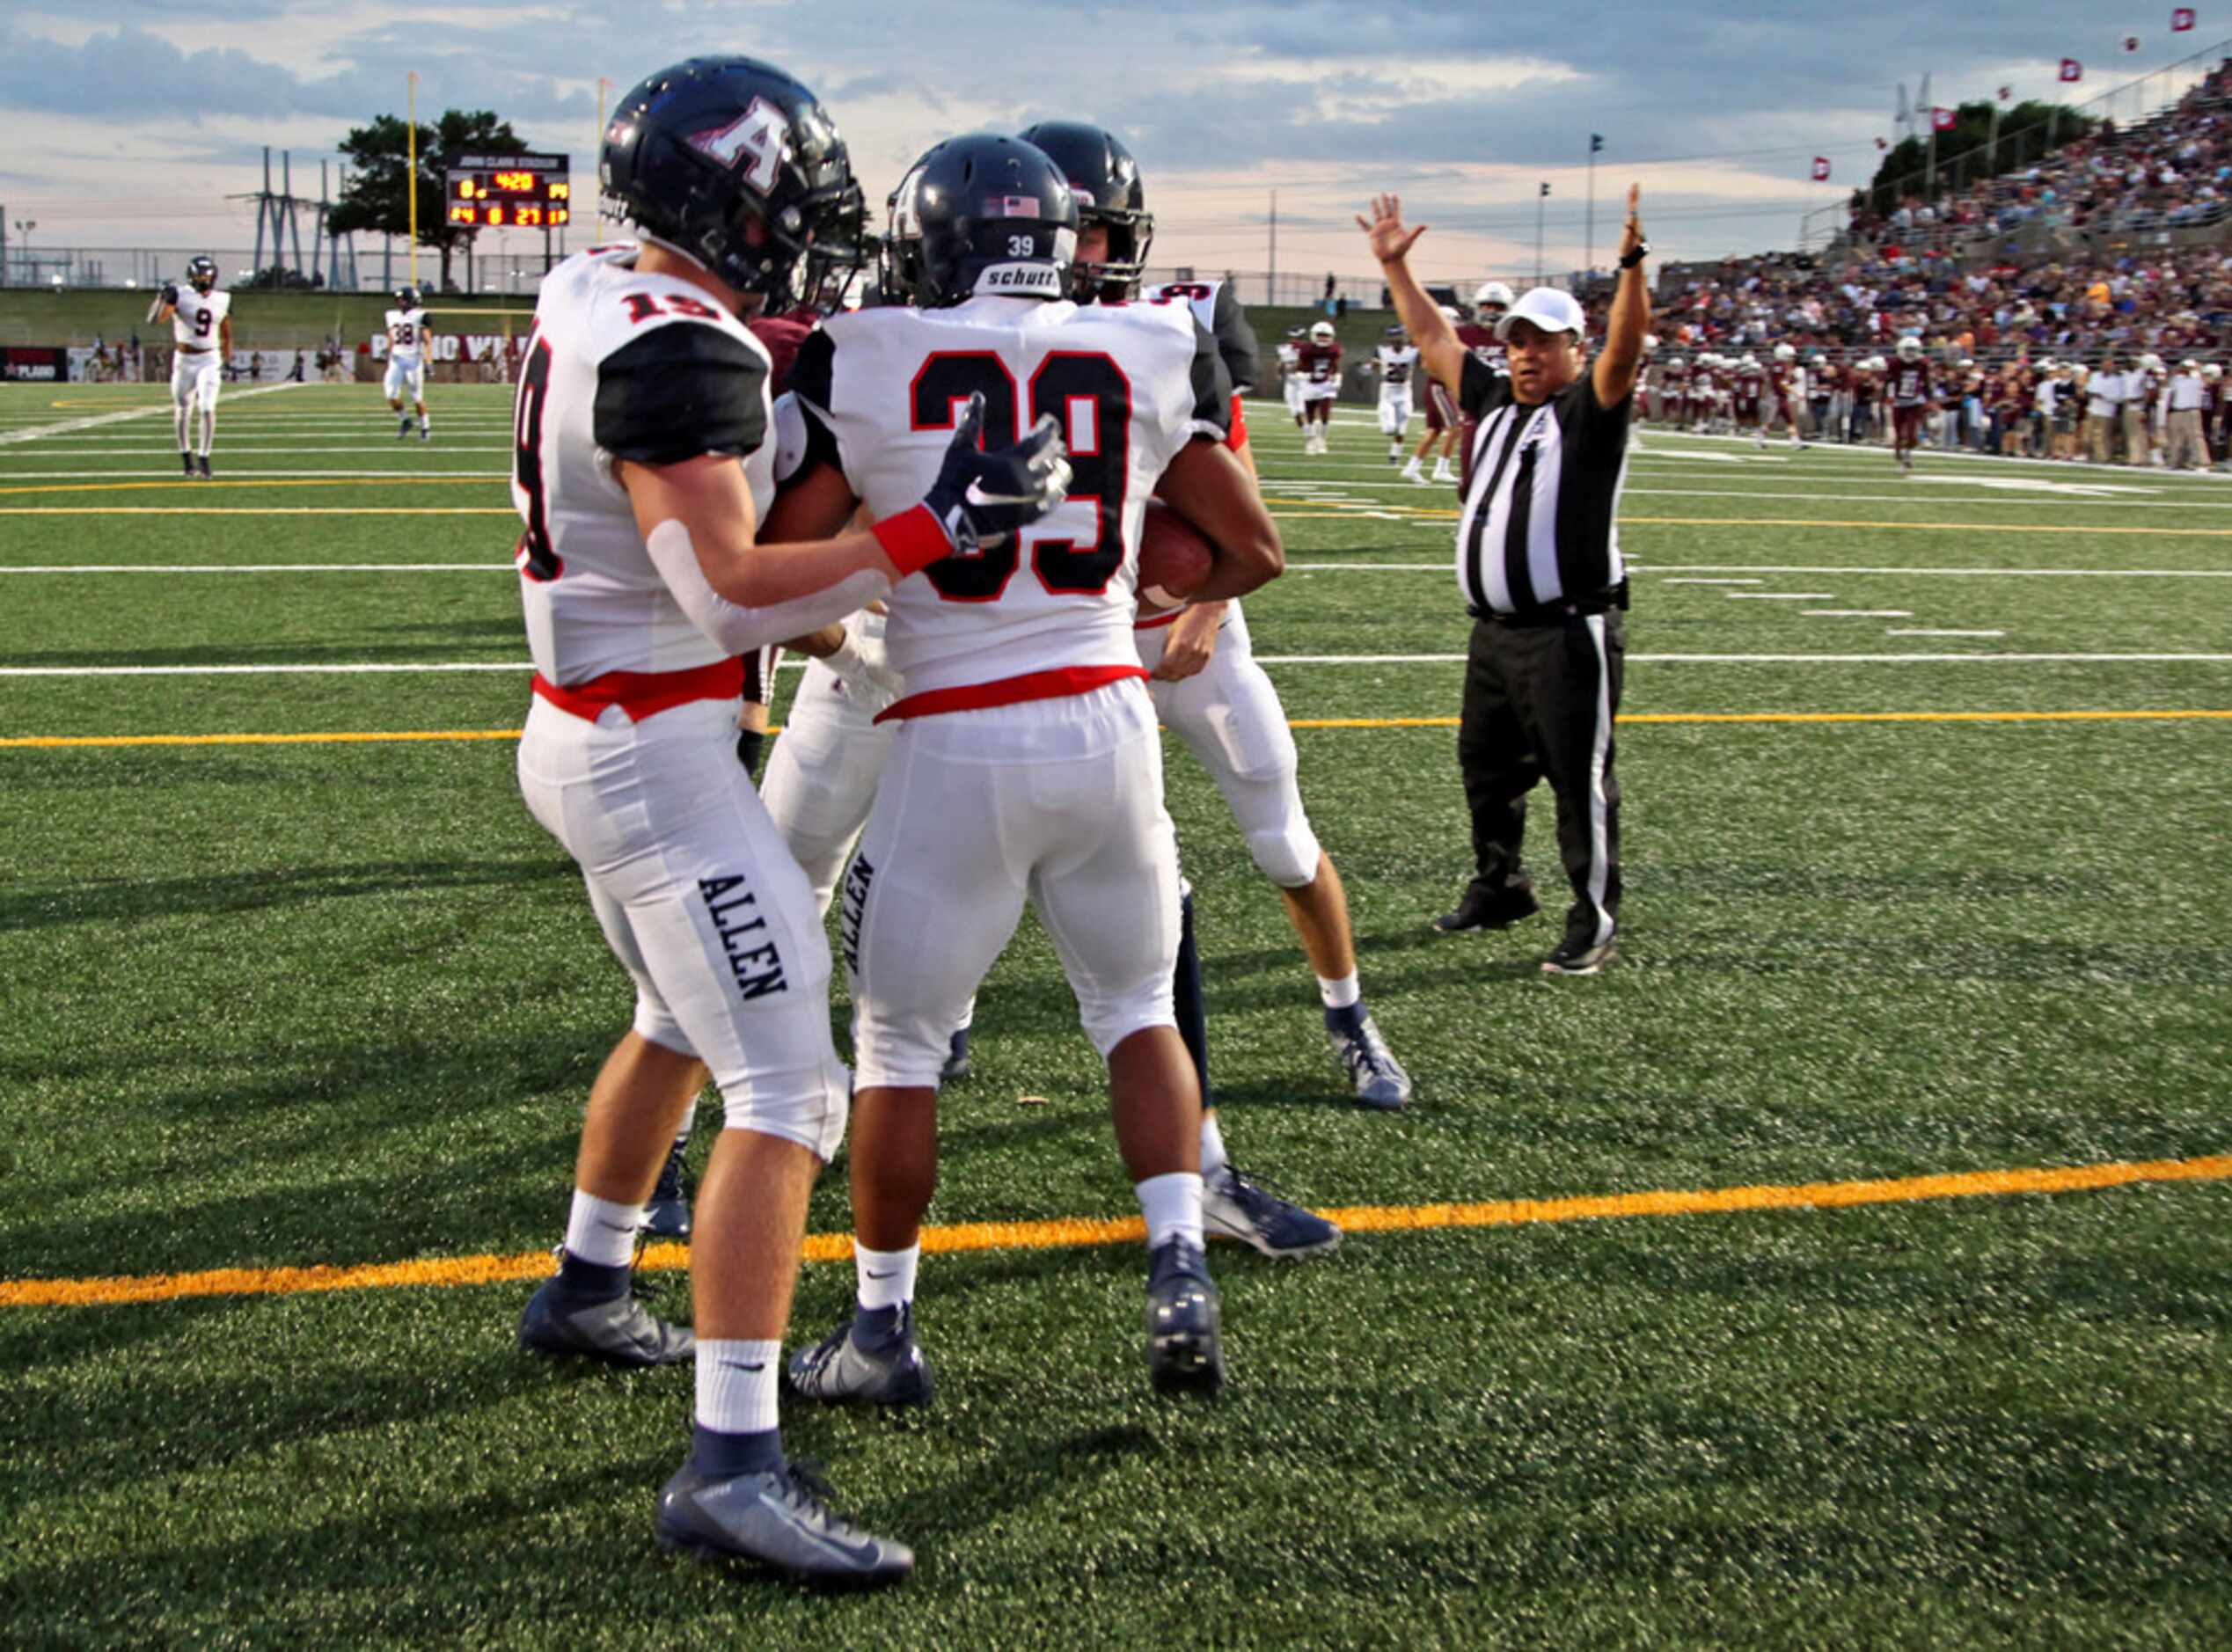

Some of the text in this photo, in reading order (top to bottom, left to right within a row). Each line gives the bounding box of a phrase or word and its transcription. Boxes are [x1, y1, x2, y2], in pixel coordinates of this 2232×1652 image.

[703, 95, 789, 197] A
[987, 267, 1054, 287] schutt
[1007, 235, 1035, 257] 39
[194, 307, 213, 338] 9
[392, 323, 414, 345] 38
[910, 349, 1131, 602] 39
[698, 874, 788, 1001] ALLEN
[843, 852, 875, 976] ALLEN
